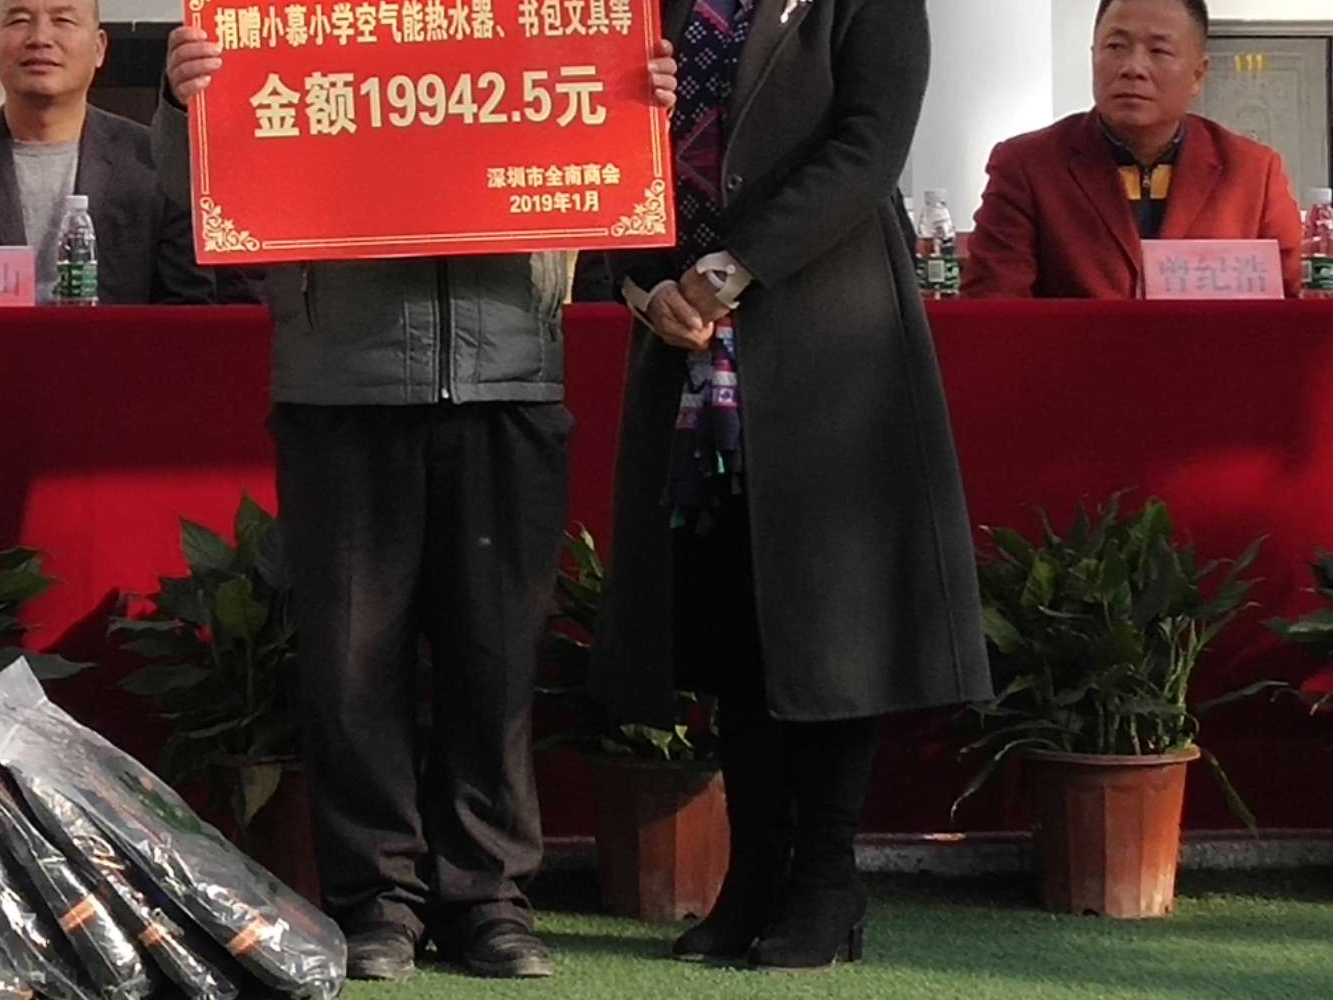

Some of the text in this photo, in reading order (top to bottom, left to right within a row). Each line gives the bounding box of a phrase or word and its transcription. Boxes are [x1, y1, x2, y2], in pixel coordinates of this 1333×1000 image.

[249, 65, 607, 139] 金额19942.5元
[487, 163, 621, 188] 深圳市全南商会
[509, 190, 600, 213] 2019年1月
